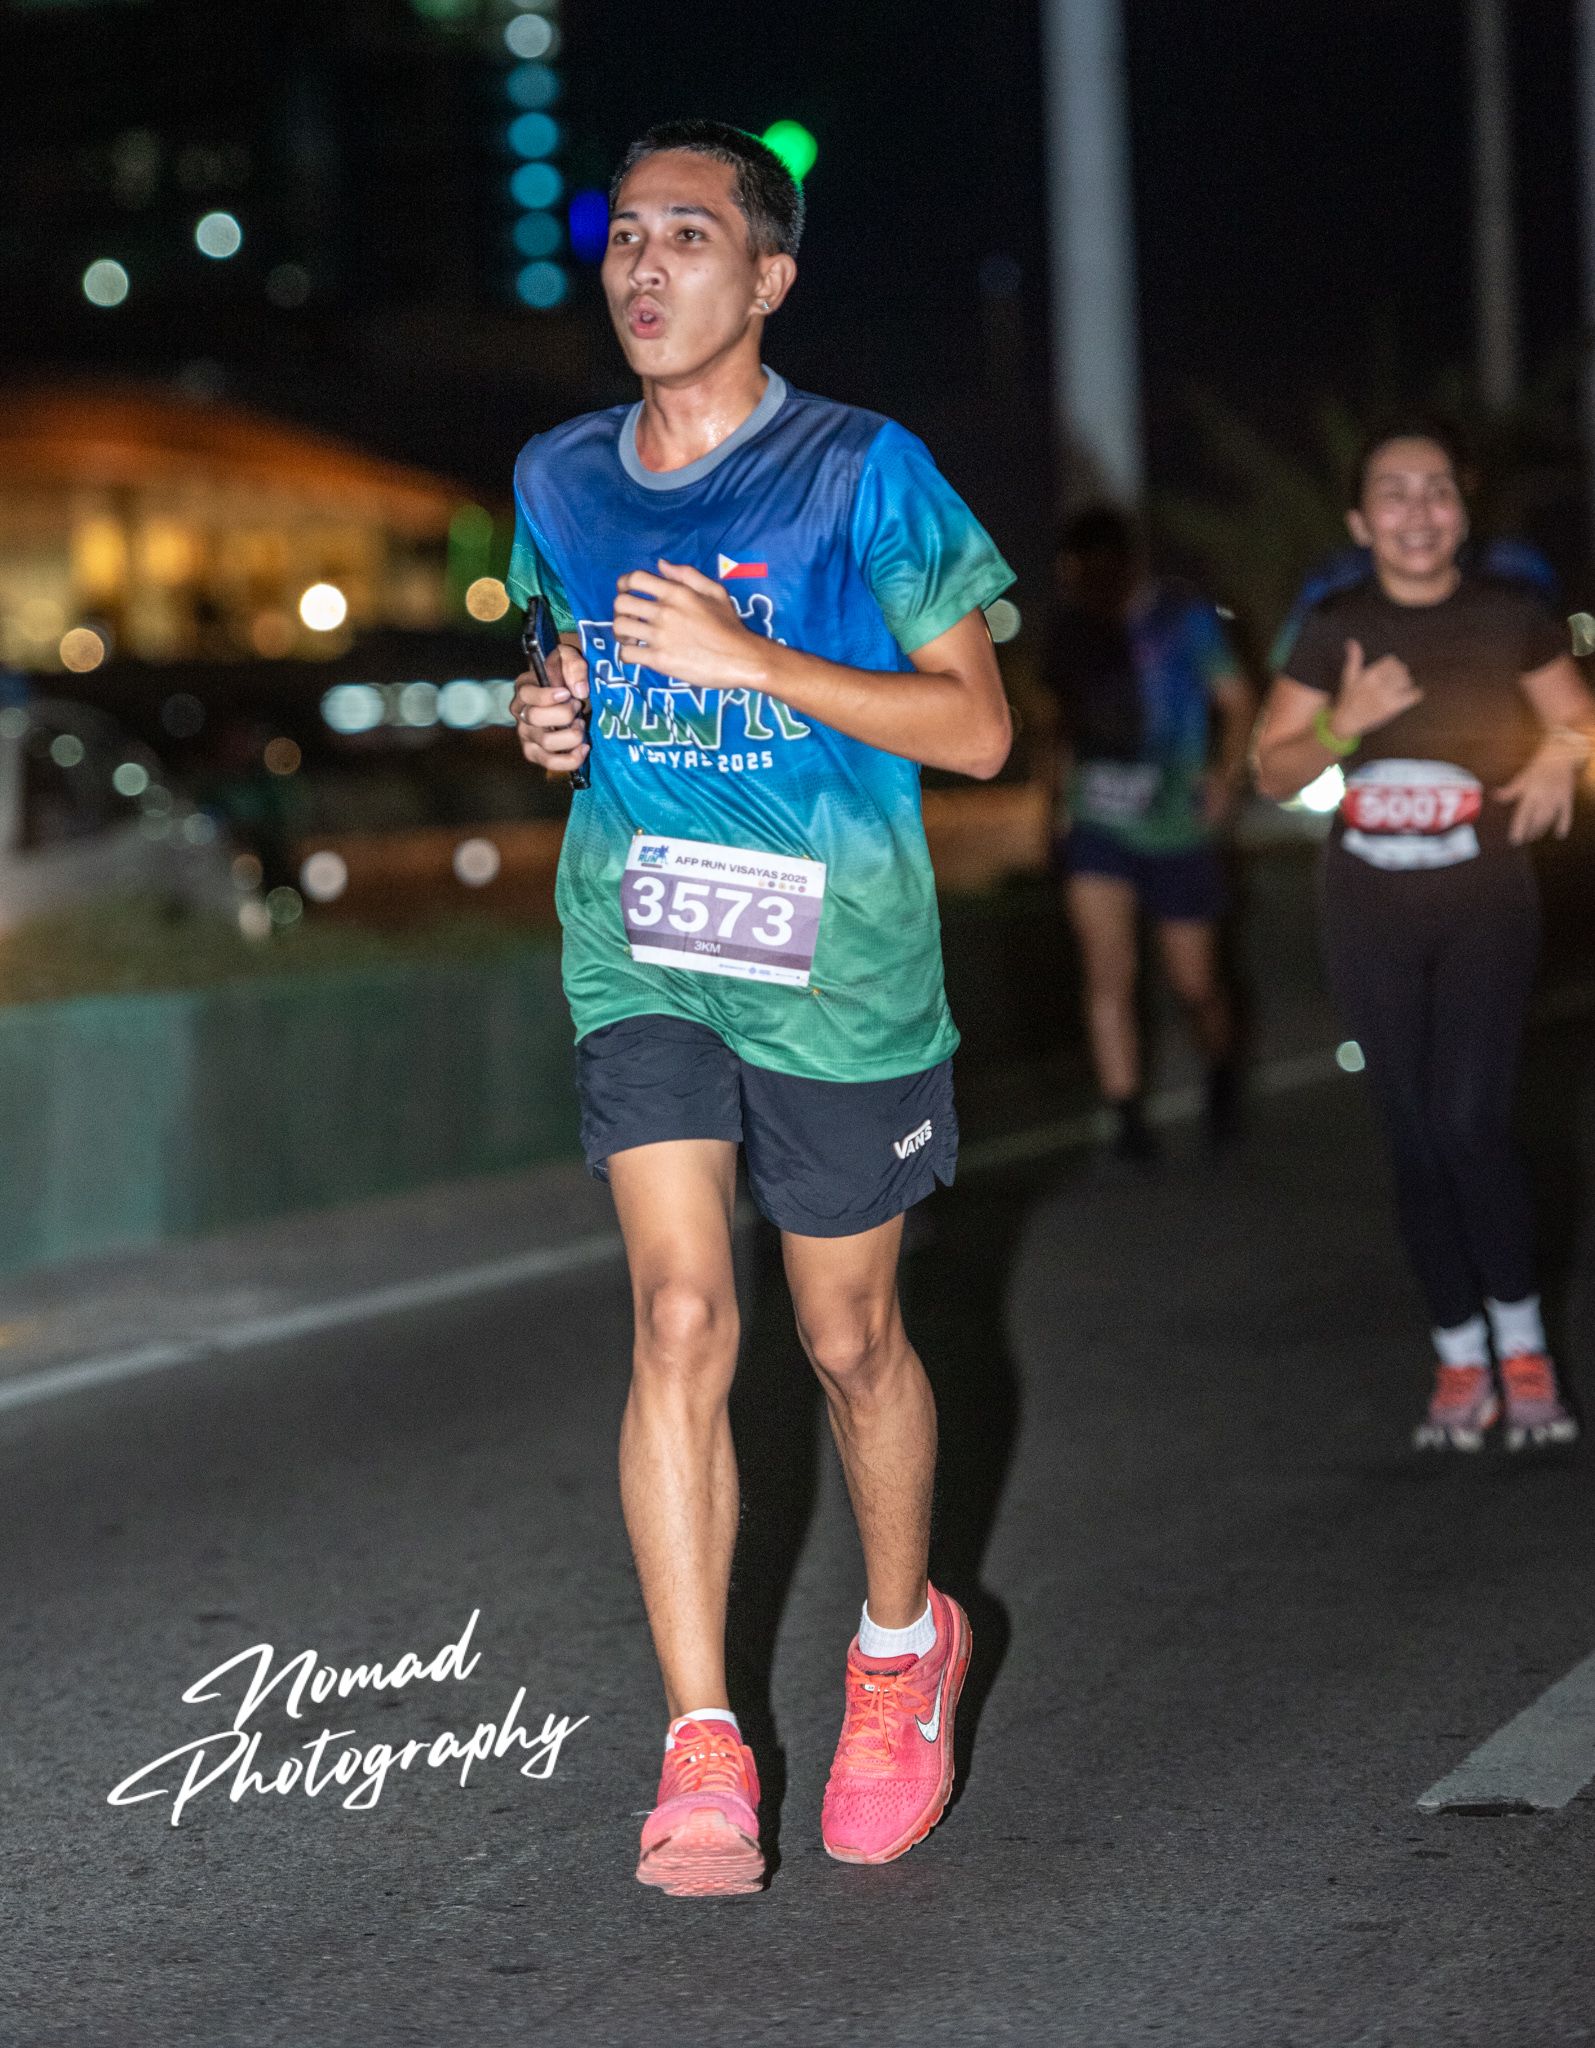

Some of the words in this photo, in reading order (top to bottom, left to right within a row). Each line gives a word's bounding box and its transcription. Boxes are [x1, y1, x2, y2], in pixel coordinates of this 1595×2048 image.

[595, 686, 722, 750] RUN
[717, 750, 774, 773] 2025
[675, 856, 699, 866] AFP
[701, 859, 726, 871] RUN
[729, 863, 778, 879] VISAYAS
[780, 872, 808, 884] 2025
[628, 876, 795, 946] 3573
[694, 940, 721, 953] 3KM
[893, 1119, 932, 1159] VANS
